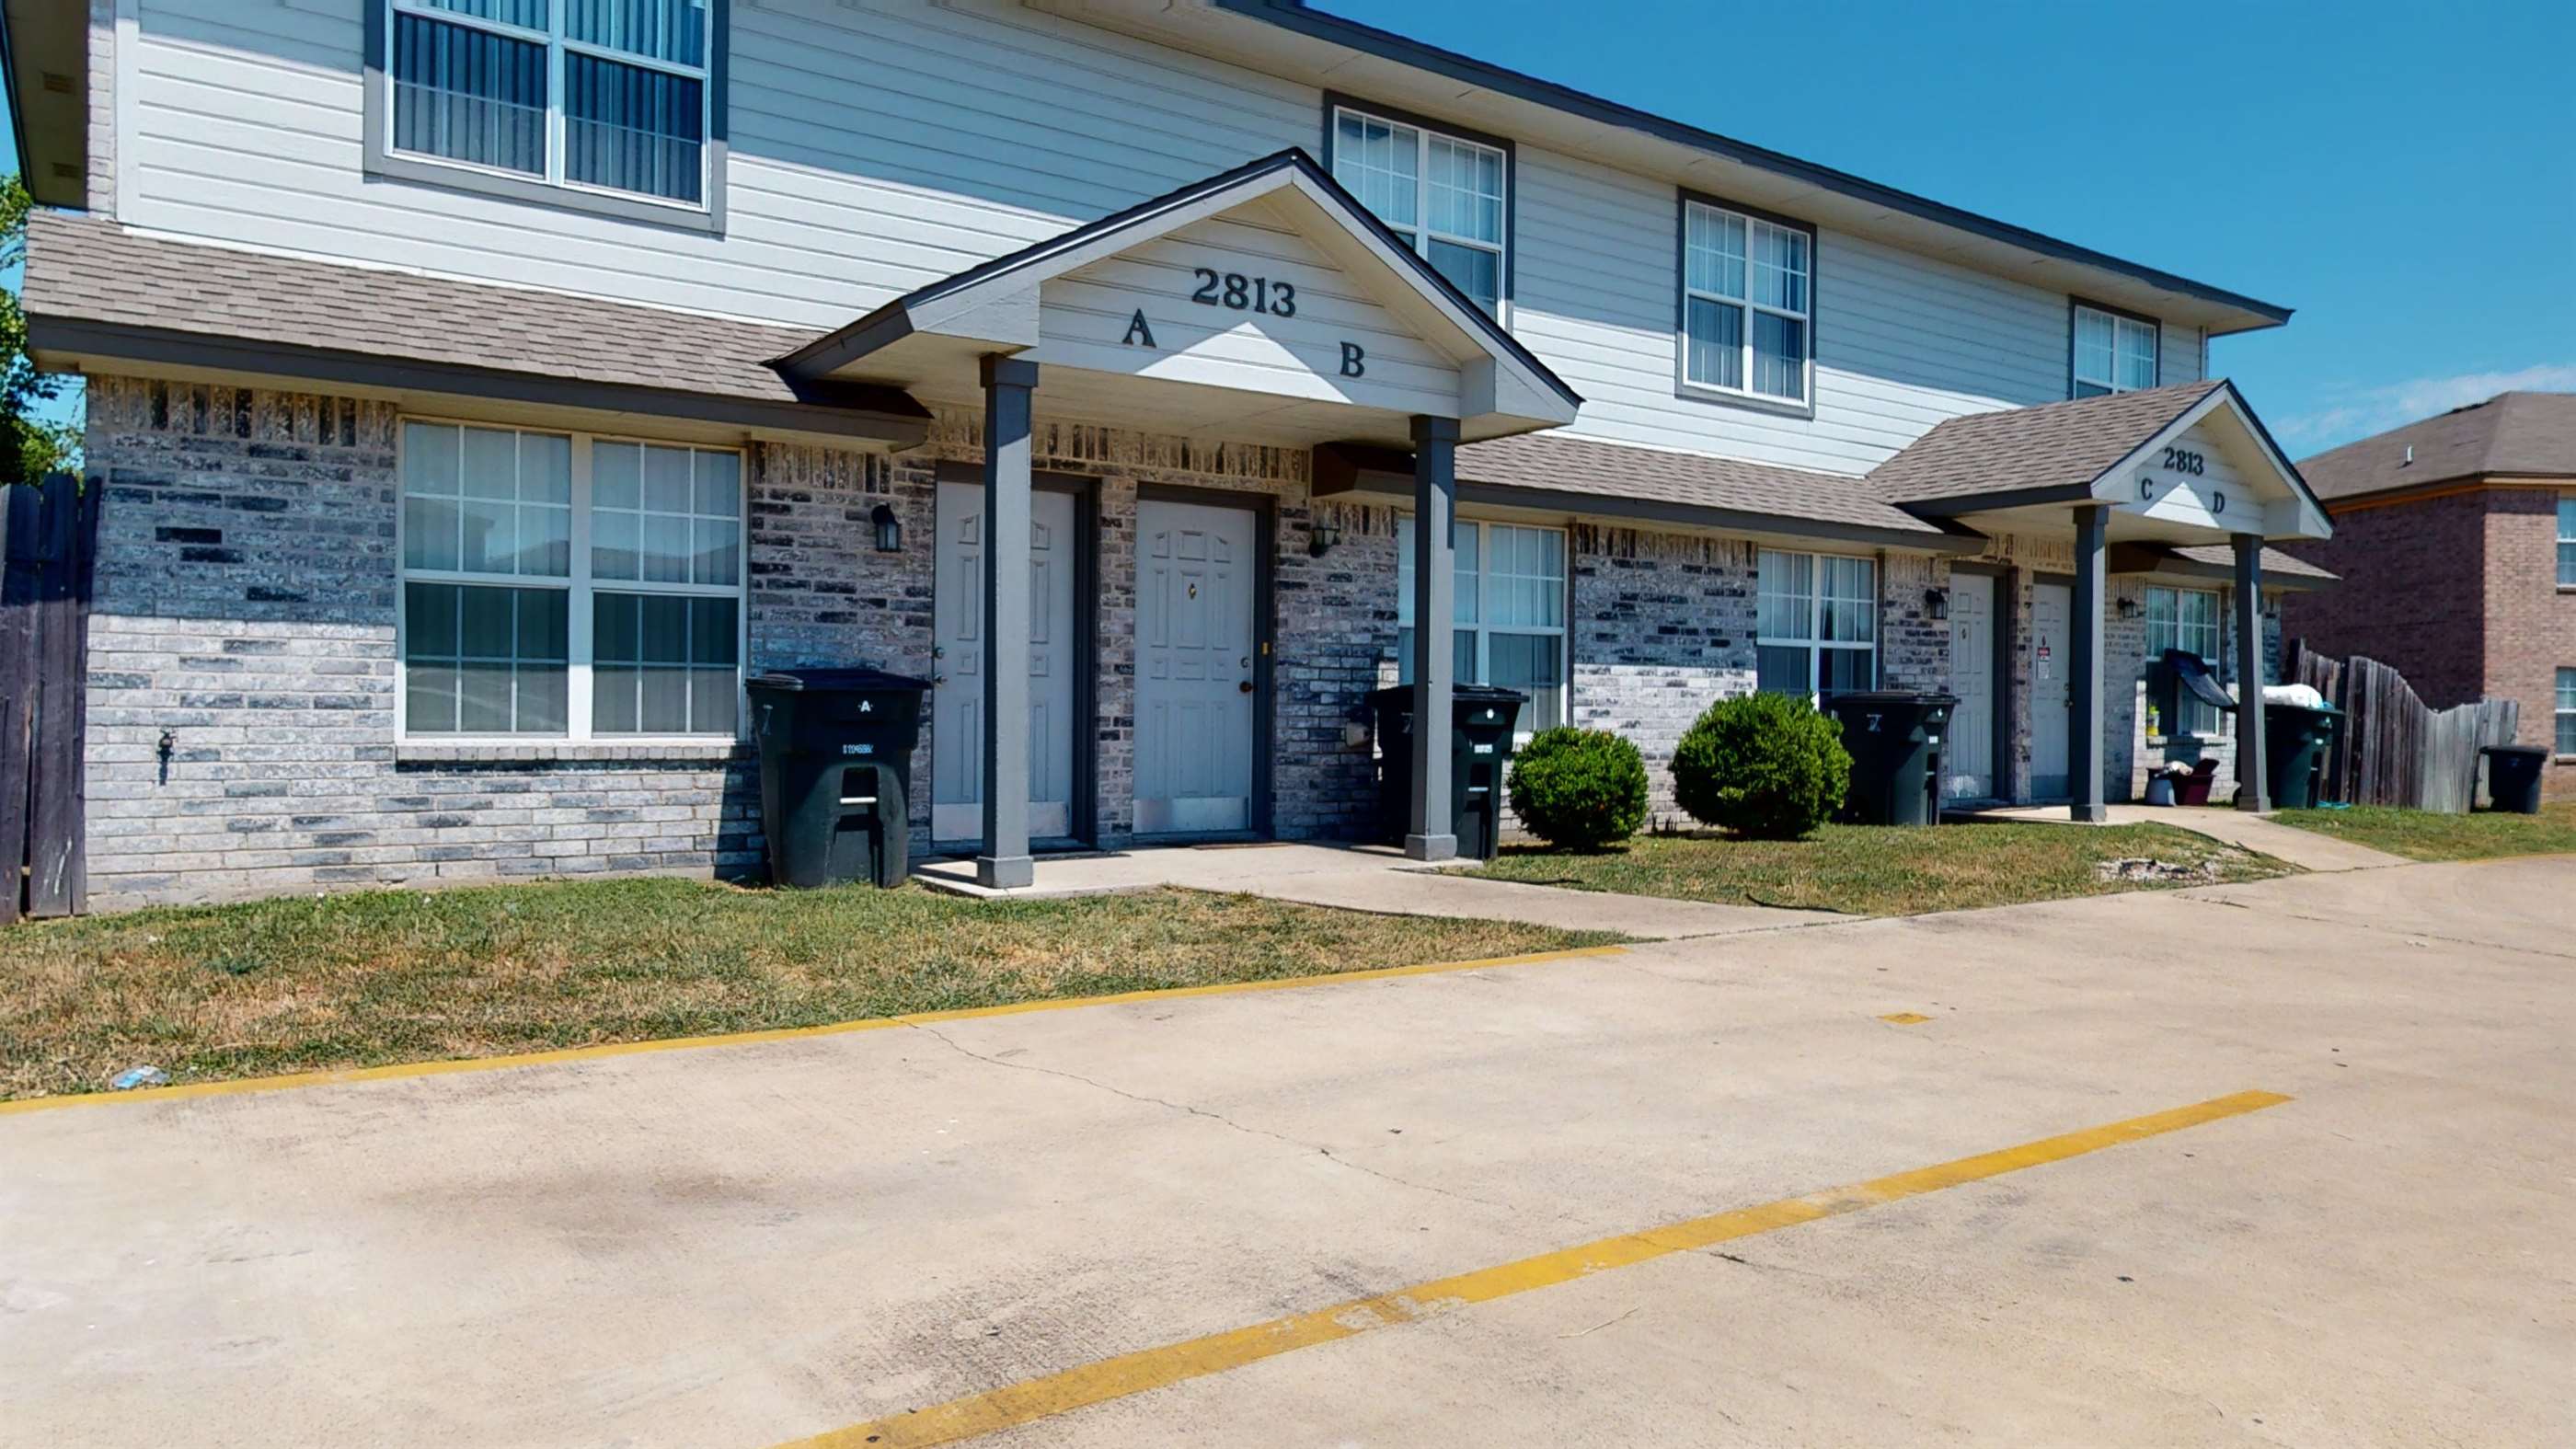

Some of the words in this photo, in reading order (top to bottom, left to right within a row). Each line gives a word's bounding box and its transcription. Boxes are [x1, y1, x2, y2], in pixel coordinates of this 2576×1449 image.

[1192, 268, 1295, 317] 2813
[1122, 308, 1156, 348] A
[1340, 341, 1364, 377] B
[2164, 447, 2203, 476] 2813
[2141, 478, 2153, 500] C
[2213, 491, 2225, 513] D
